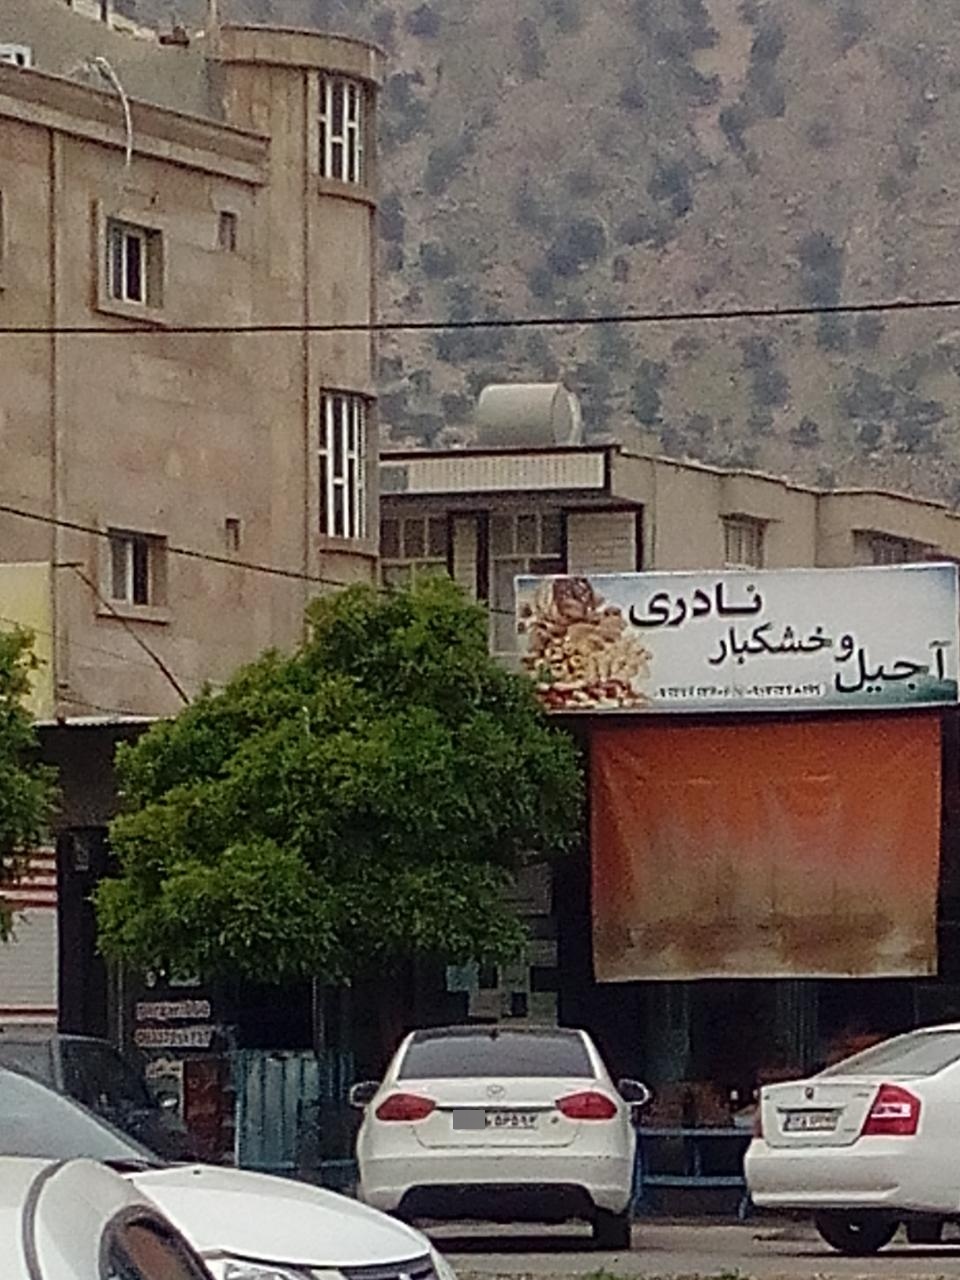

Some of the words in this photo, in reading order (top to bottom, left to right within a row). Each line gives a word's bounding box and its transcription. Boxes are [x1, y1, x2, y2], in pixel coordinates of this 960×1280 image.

[628, 582, 762, 628] نادری
[708, 623, 831, 666] خشکبار
[834, 640, 951, 694] آجیل
